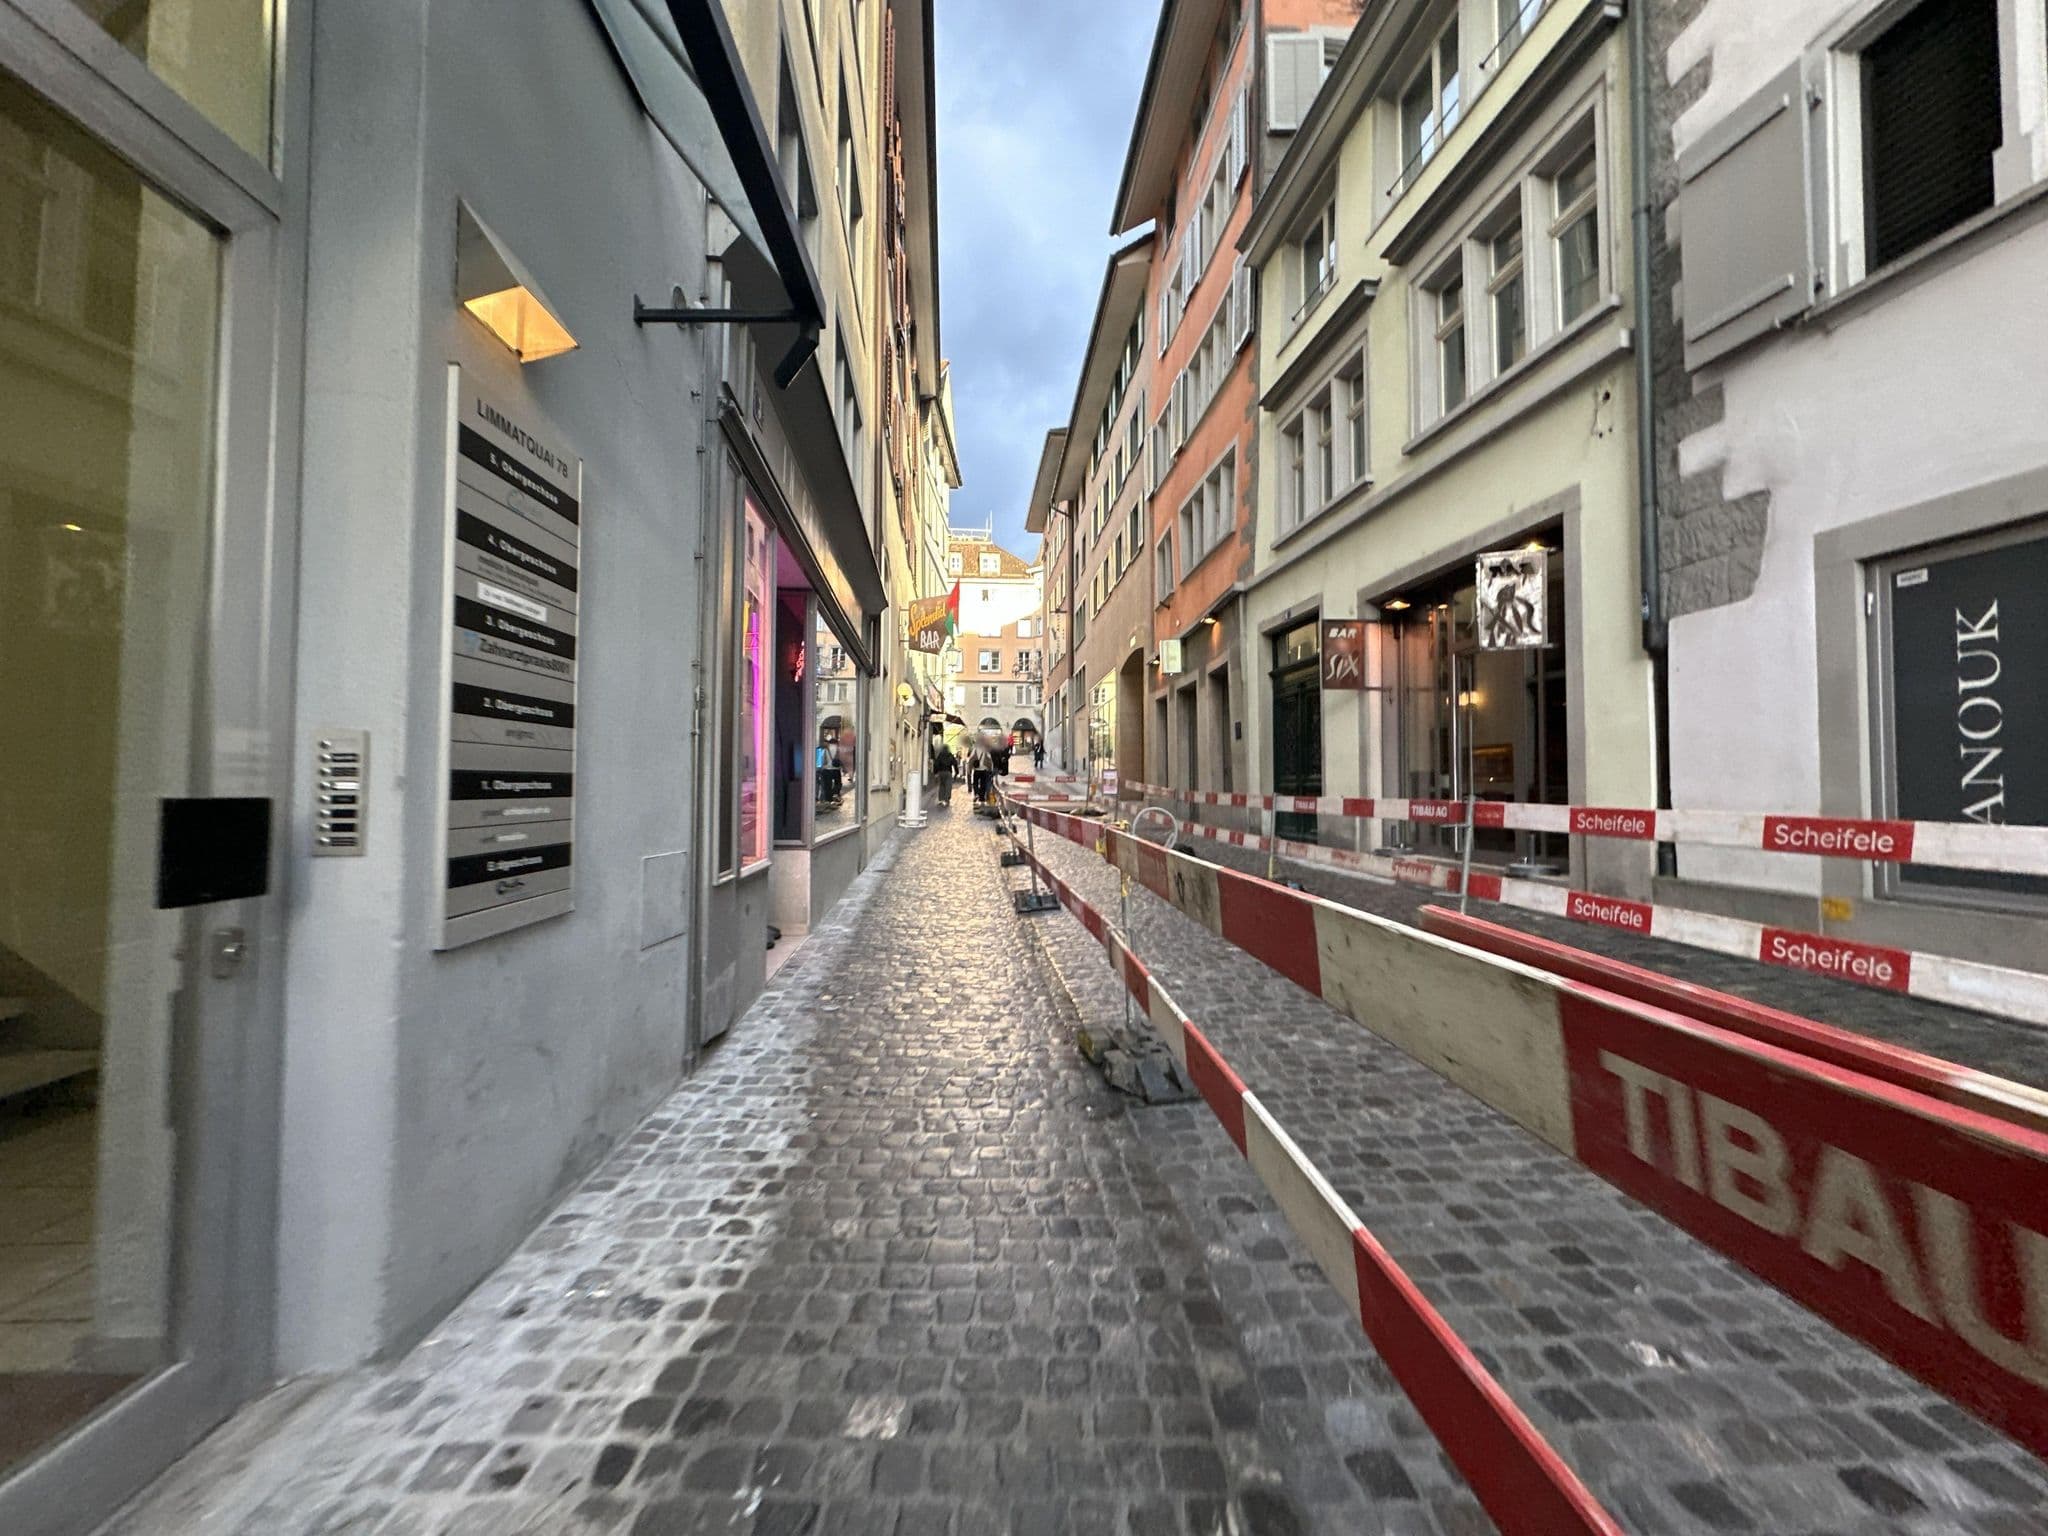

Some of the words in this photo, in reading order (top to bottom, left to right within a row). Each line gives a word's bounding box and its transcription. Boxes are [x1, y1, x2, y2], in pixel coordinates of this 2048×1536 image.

[477, 398, 555, 468] LIMMATQUAI
[557, 459, 569, 478] 78
[501, 461, 559, 504] Obergeschoss
[500, 540, 557, 575] Obergeschoss
[498, 619, 556, 646] Obergeschoss
[920, 630, 940, 649] BAR
[1328, 627, 1358, 639] BAR
[495, 699, 554, 718] Obergeschoss
[1956, 599, 2005, 825] ANOUK
[1411, 804, 1435, 817] TIBAU
[1435, 806, 1448, 818] AG
[1576, 812, 1646, 834] Scheifele
[1773, 823, 1895, 854] Scheifele
[1573, 897, 1643, 928] Scheifele
[1771, 936, 1893, 982] Scheifele
[1600, 1048, 2048, 1391] TIBAU
